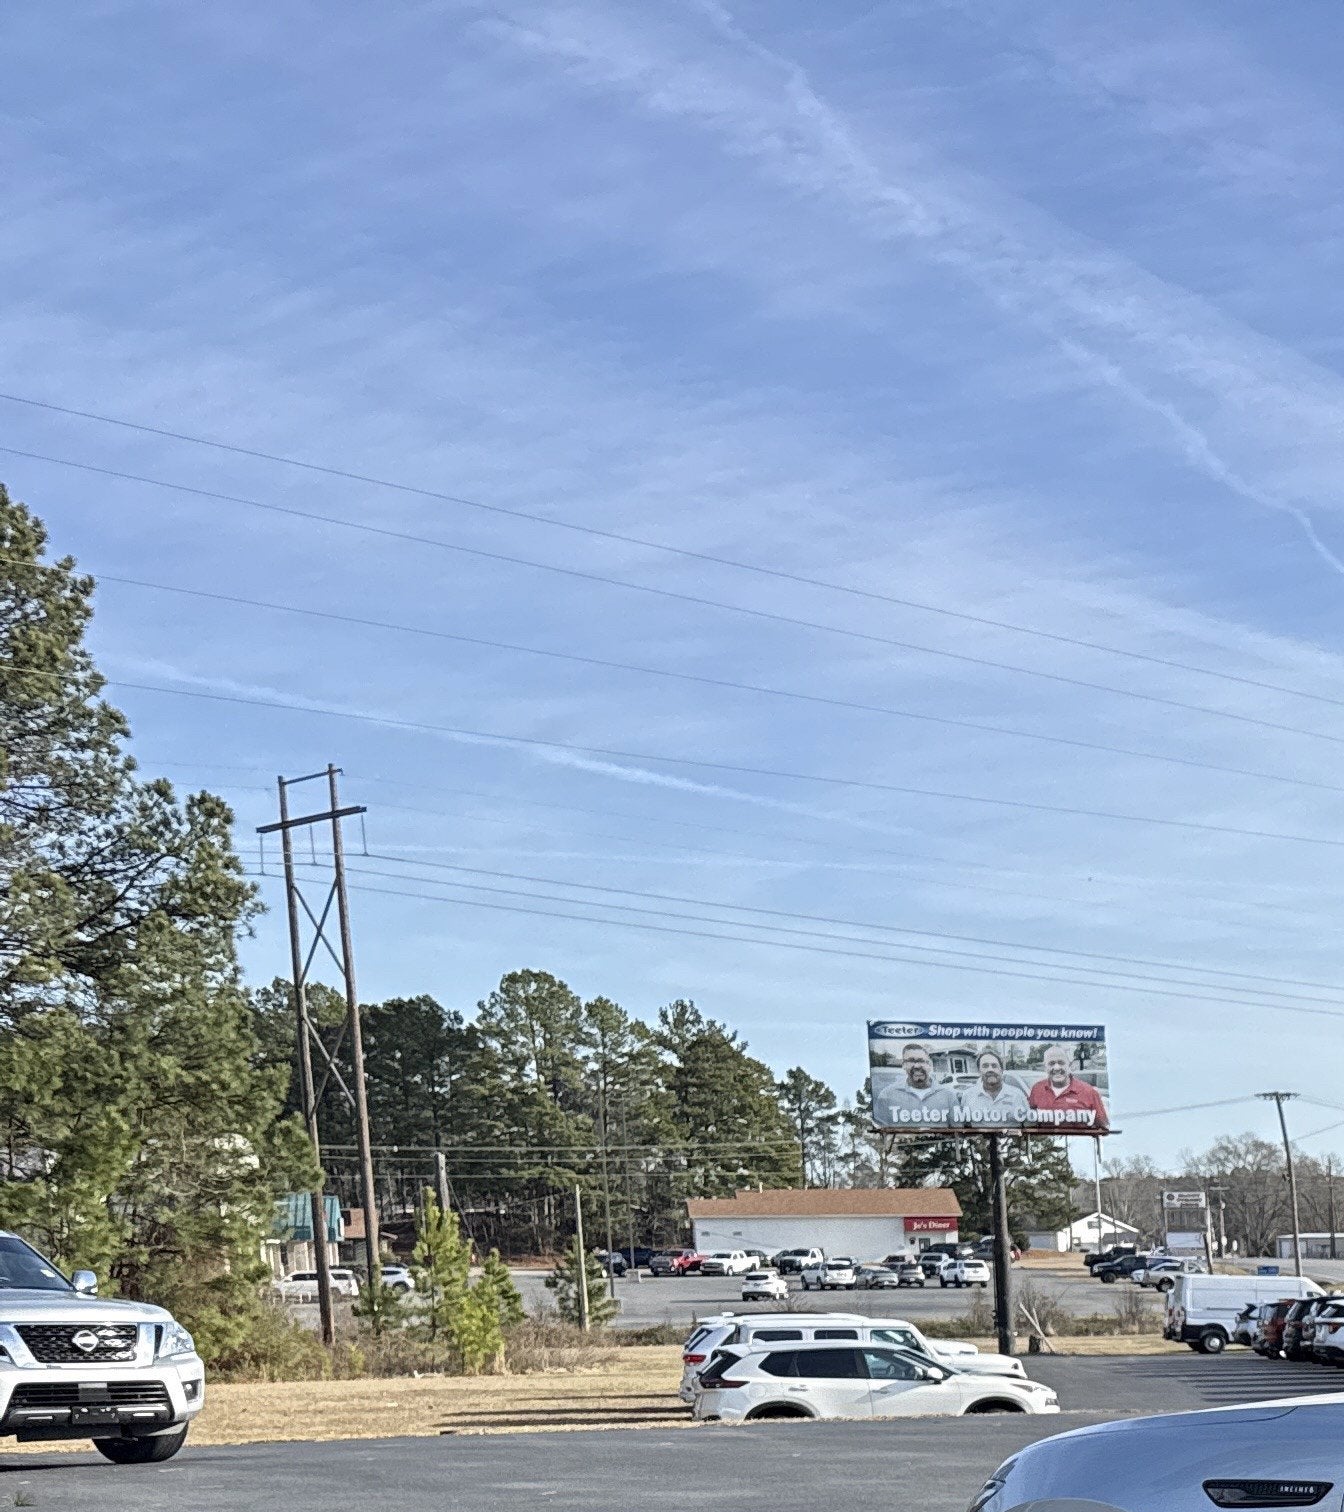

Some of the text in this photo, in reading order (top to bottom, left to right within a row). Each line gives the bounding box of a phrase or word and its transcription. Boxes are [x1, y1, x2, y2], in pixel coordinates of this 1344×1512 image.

[882, 1025, 919, 1035] Teeter
[927, 1024, 1098, 1040] Shop with people you know!
[889, 1105, 1097, 1126] Teeter Motor Company
